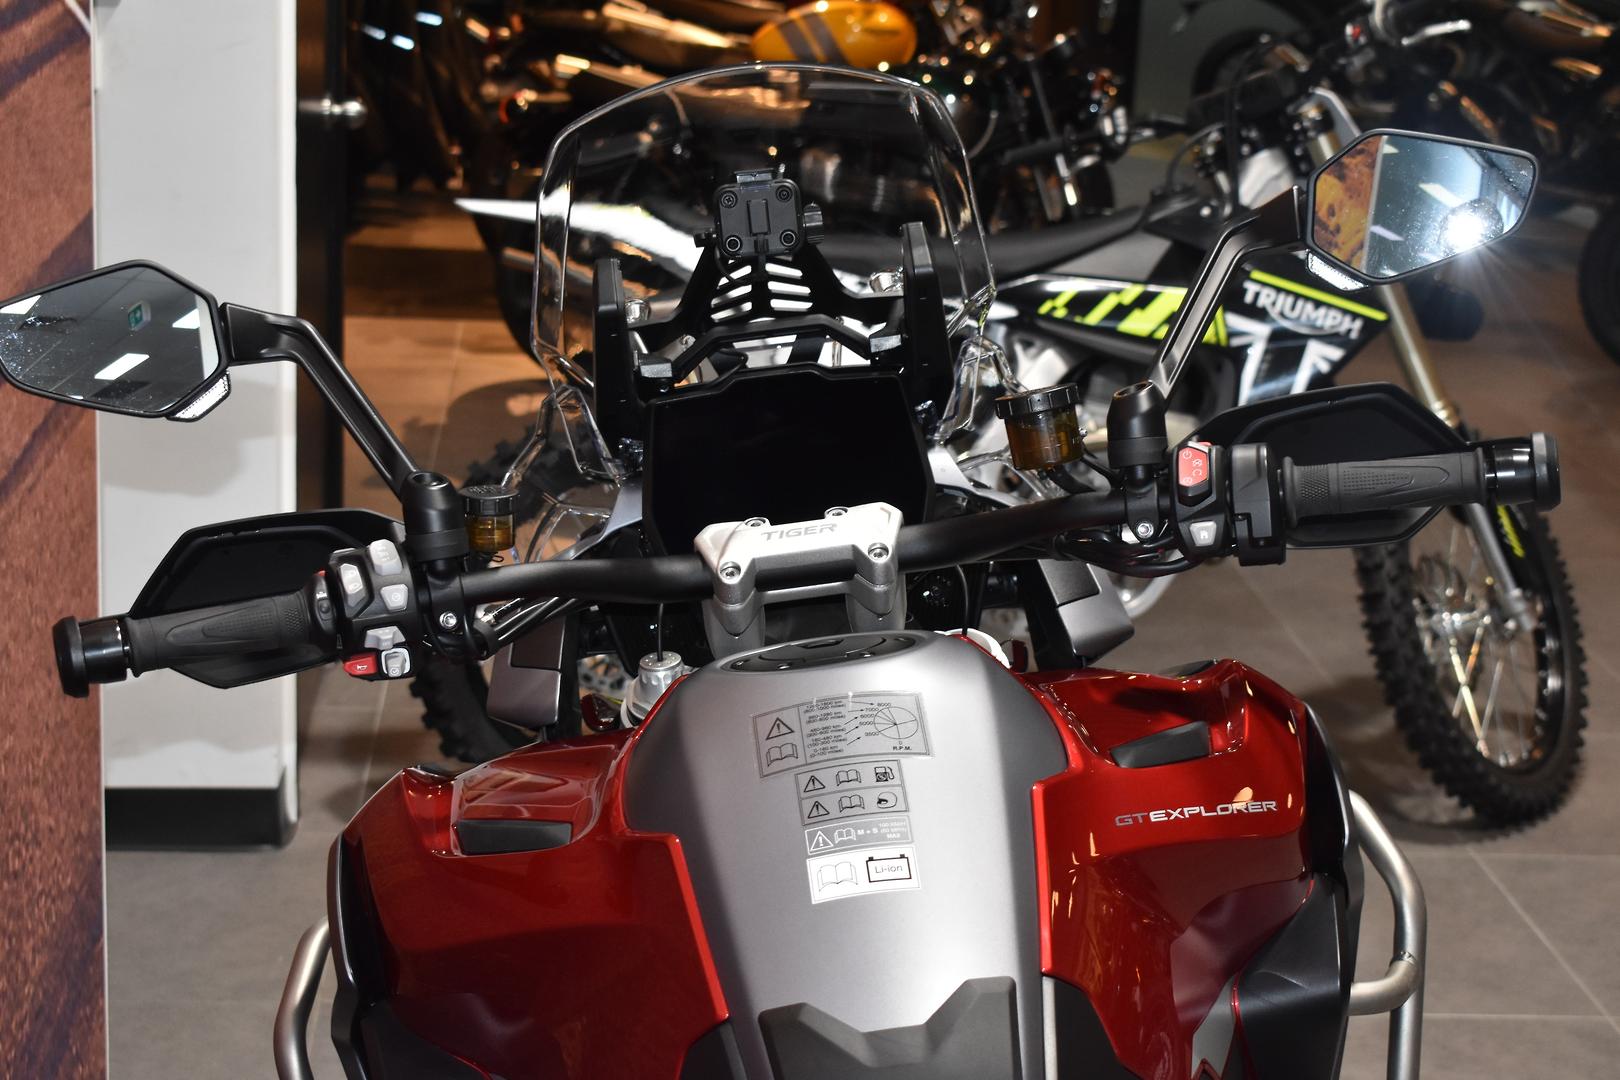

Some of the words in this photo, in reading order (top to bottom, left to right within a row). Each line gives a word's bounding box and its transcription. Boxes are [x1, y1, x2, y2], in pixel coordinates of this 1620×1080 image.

[1242, 280, 1364, 340] TRIUMPH
[761, 523, 837, 541] TIGER
[875, 864, 903, 874] Li-ion
